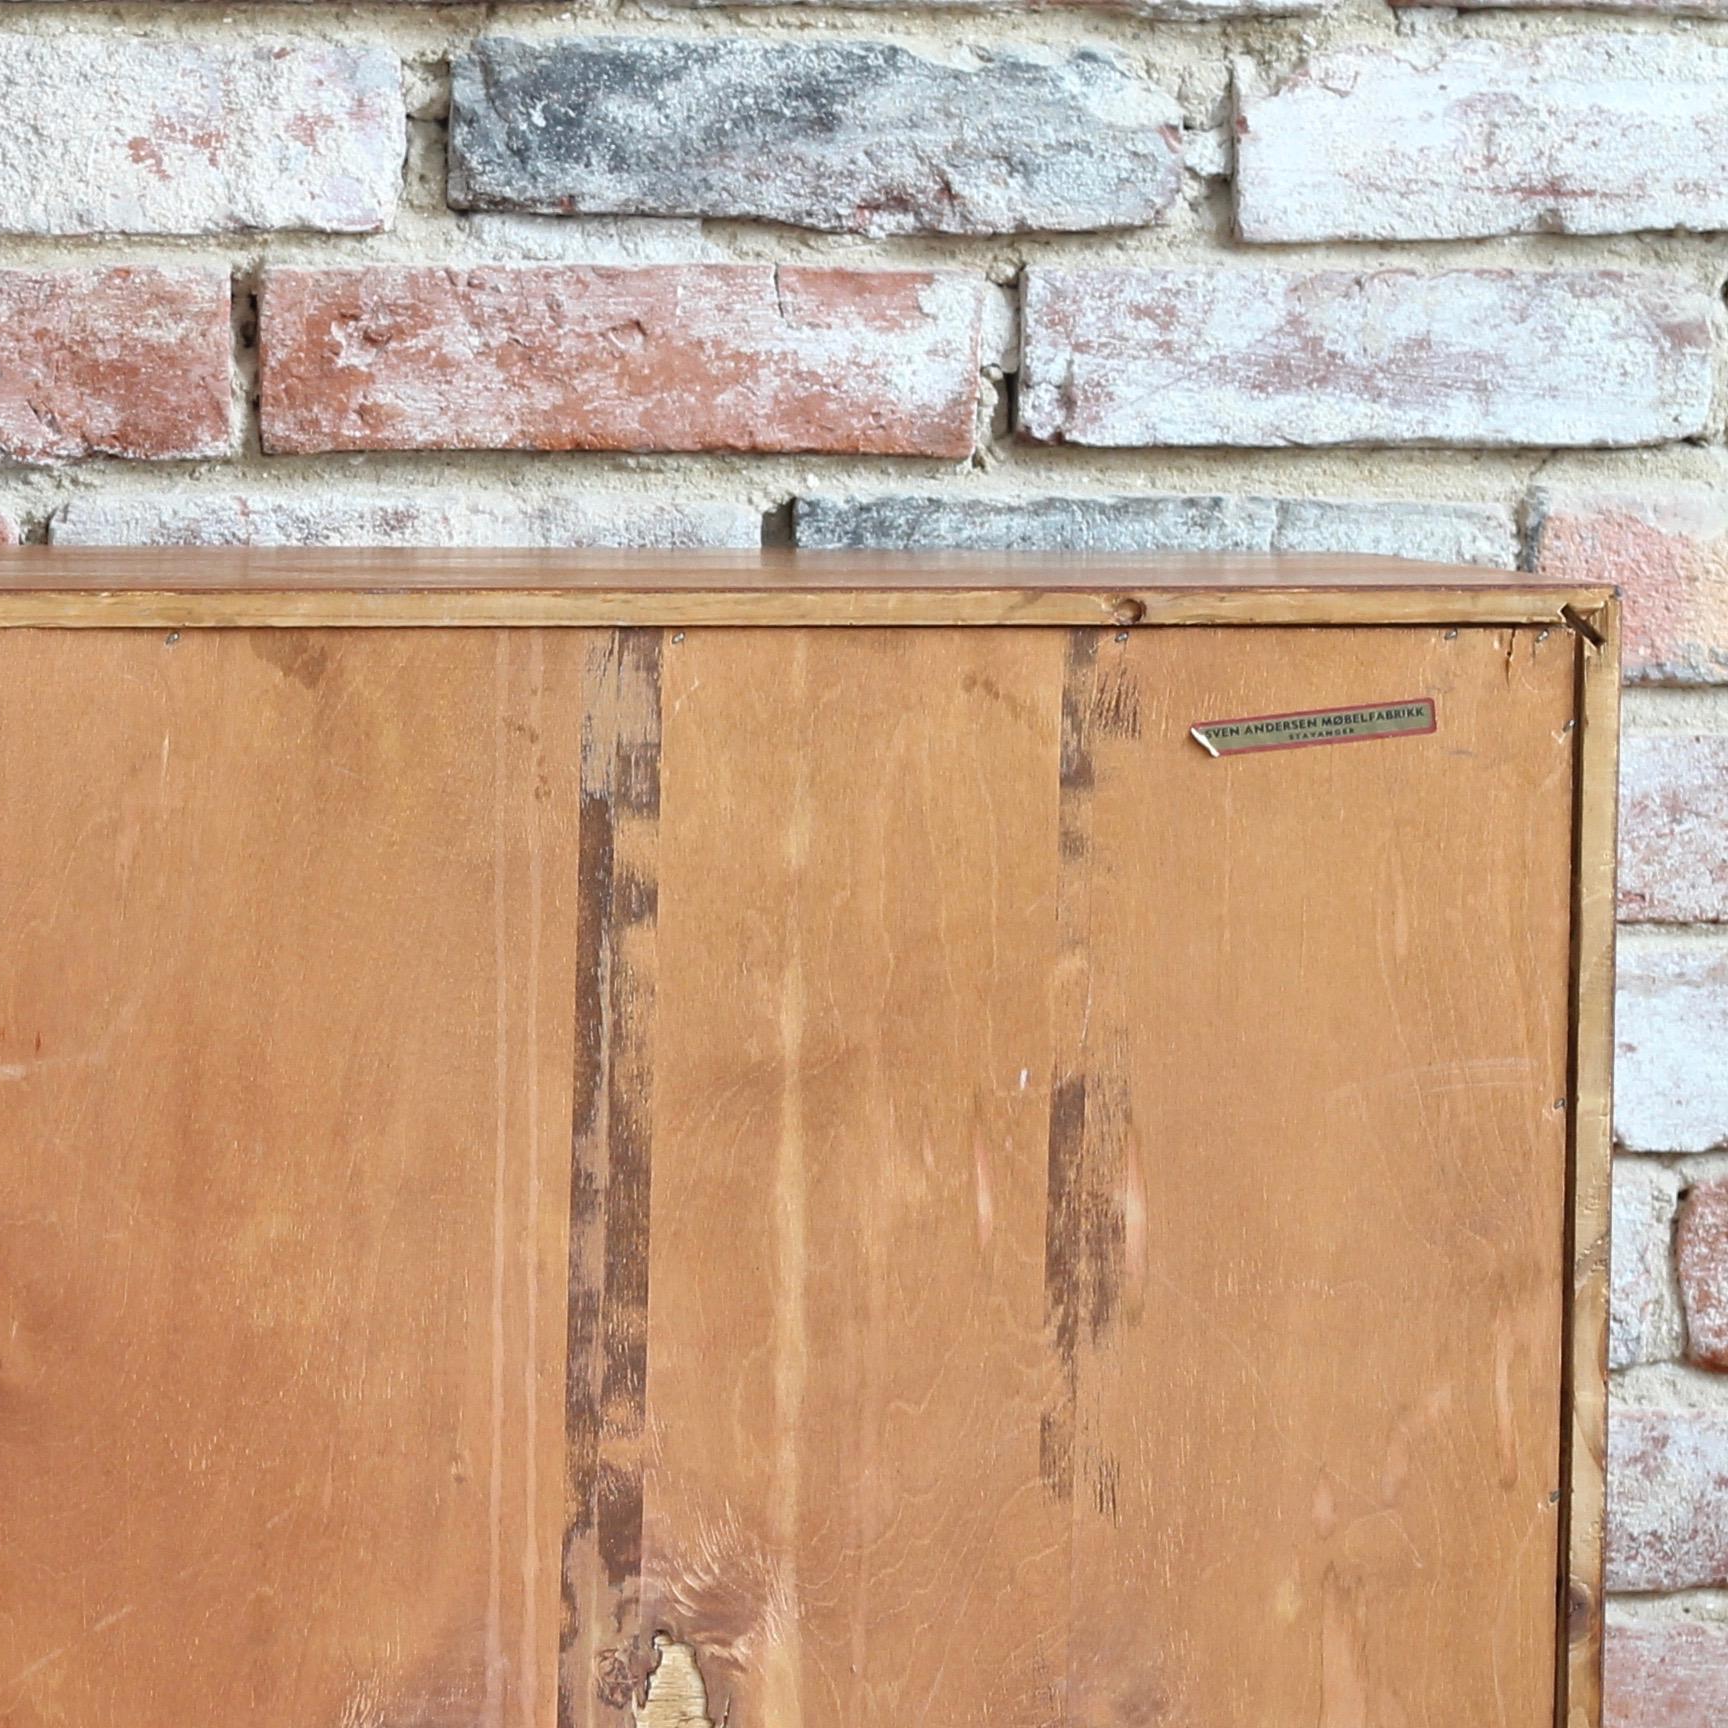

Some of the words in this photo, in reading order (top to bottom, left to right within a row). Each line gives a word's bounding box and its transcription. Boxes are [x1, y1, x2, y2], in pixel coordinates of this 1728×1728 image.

[1204, 727, 1240, 739] SVEN
[1244, 718, 1317, 735] ANDERSEN
[1321, 706, 1425, 727] MØBELFABRIKK
